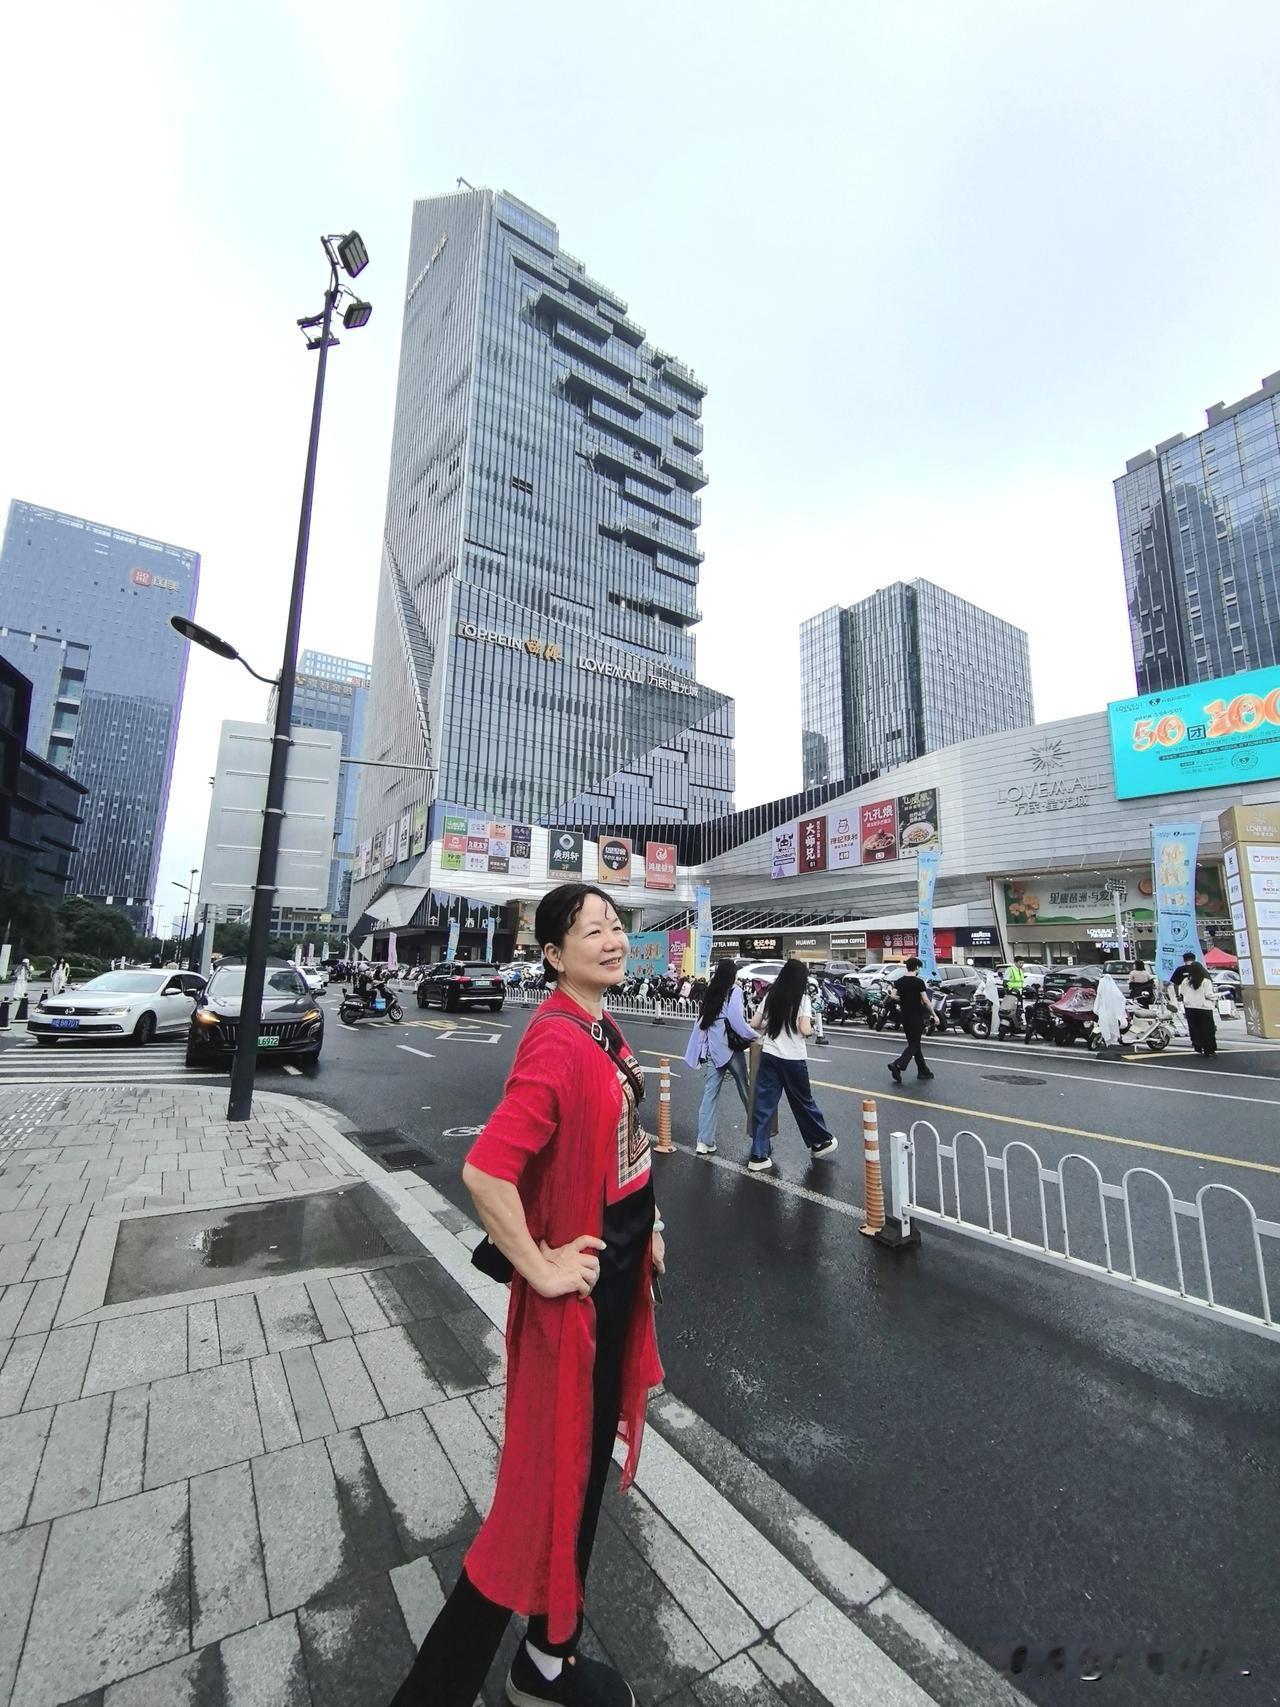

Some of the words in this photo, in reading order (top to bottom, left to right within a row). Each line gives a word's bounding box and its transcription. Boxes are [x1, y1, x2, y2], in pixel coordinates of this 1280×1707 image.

[464, 624, 523, 650] OPPEIN
[578, 655, 644, 684] LOVEMALL
[1132, 715, 1185, 751] 50
[996, 772, 1109, 805] LOVEMALL
